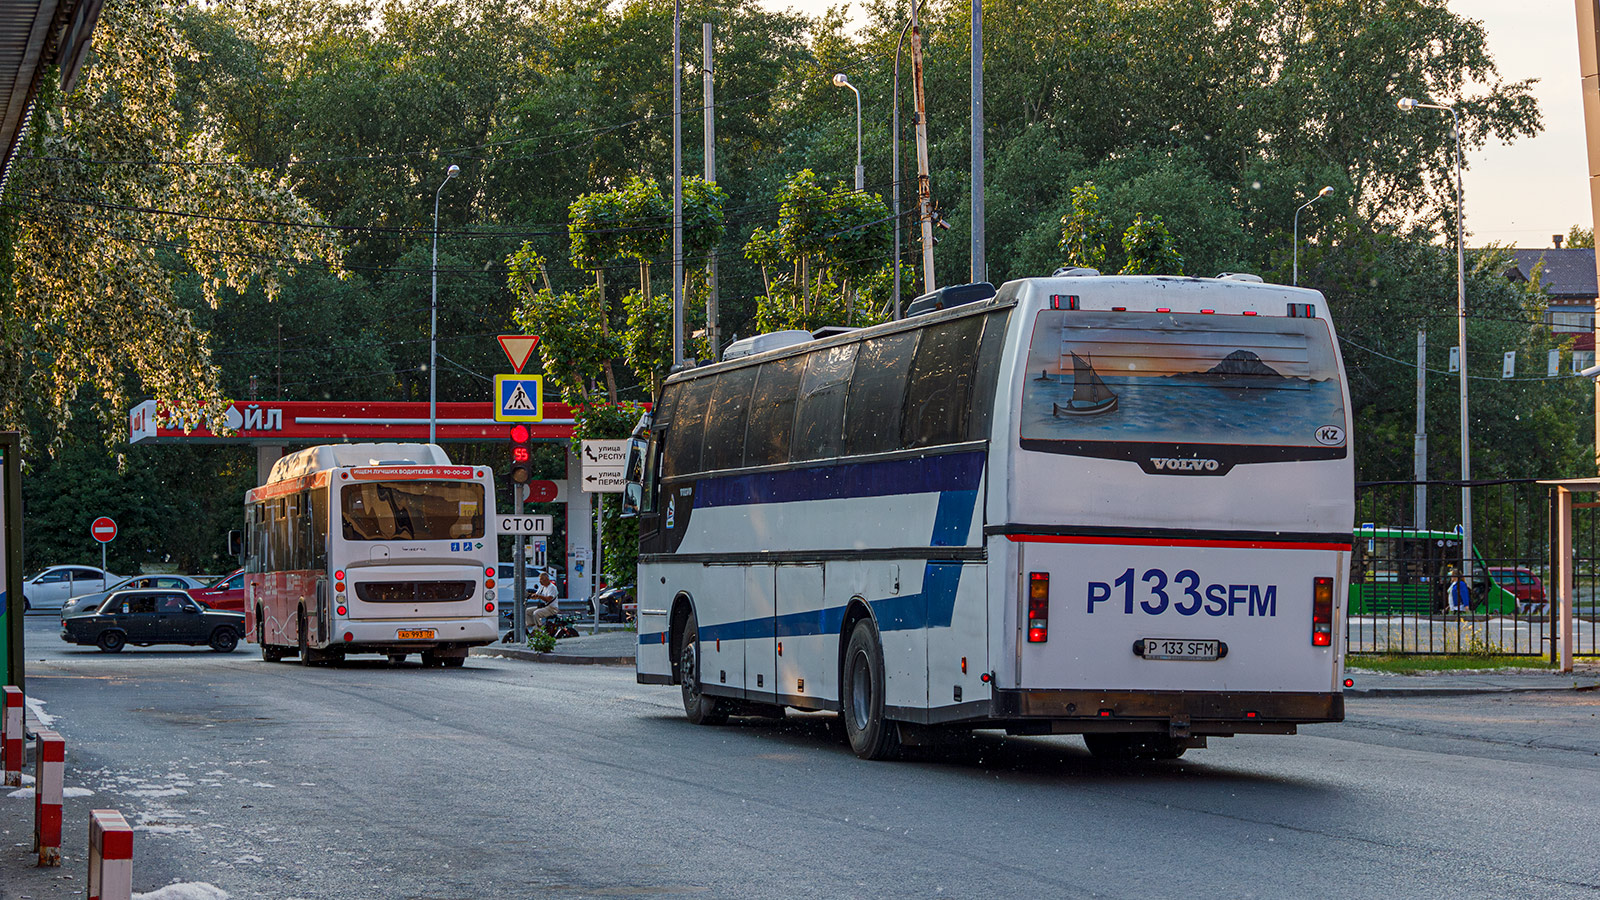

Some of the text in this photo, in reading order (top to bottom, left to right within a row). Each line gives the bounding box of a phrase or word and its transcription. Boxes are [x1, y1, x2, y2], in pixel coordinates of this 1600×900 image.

[1321, 429, 1338, 440] KZ
[1150, 457, 1219, 471] VOLVO
[502, 518, 545, 531] СТОП
[1149, 641, 1214, 656] P 133 SFM
